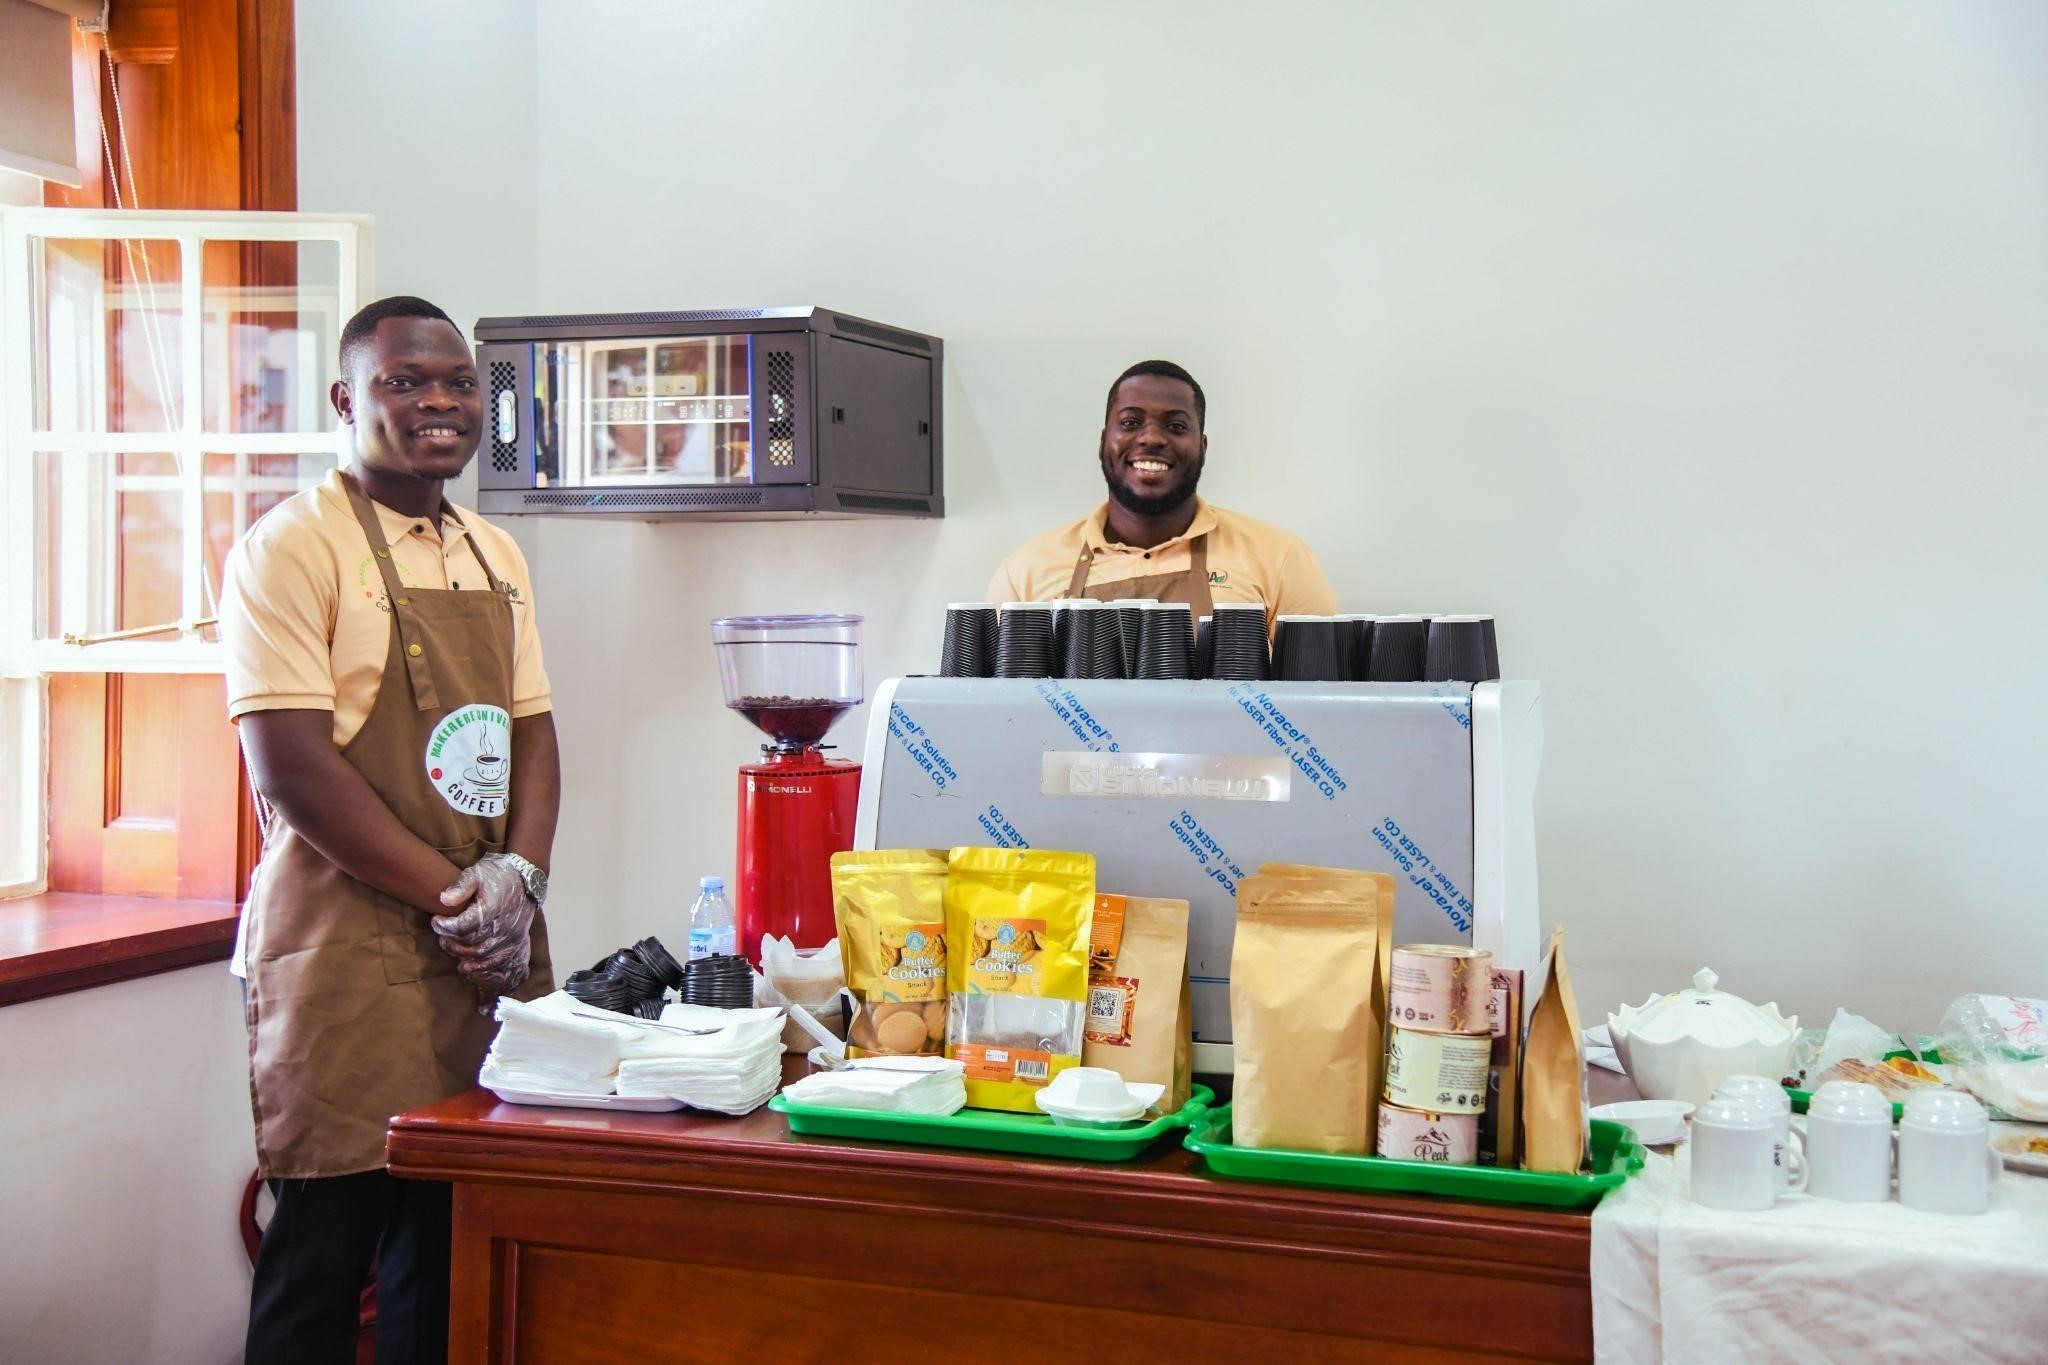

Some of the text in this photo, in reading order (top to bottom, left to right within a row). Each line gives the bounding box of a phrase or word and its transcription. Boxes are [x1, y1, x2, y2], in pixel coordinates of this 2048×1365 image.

[431, 711, 475, 758] MAKERERE
[1045, 695, 1071, 721] LASER
[1068, 719, 1090, 743] Fiber
[889, 719, 904, 739] iber
[907, 743, 933, 772] LASER
[1239, 698, 1265, 725] LASER
[1264, 723, 1286, 747] Fiber
[1291, 752, 1320, 782] LASER
[922, 738, 957, 781] Solution
[1307, 747, 1347, 790] Solution
[448, 783, 495, 813] COFFEE
[978, 814, 1011, 848] olution
[1002, 822, 1030, 849] LASER
[1169, 820, 1209, 864] Solution
[1195, 827, 1224, 860] LASER
[1372, 826, 1413, 872] Solution
[1399, 835, 1430, 867] LASER
[1434, 872, 1459, 898] Fiber
[903, 956, 935, 967] Butter
[974, 957, 1033, 973] Cookies
[990, 949, 1021, 959] Butter
[888, 964, 946, 980] Cookies
[1414, 1144, 1449, 1161] Peak
